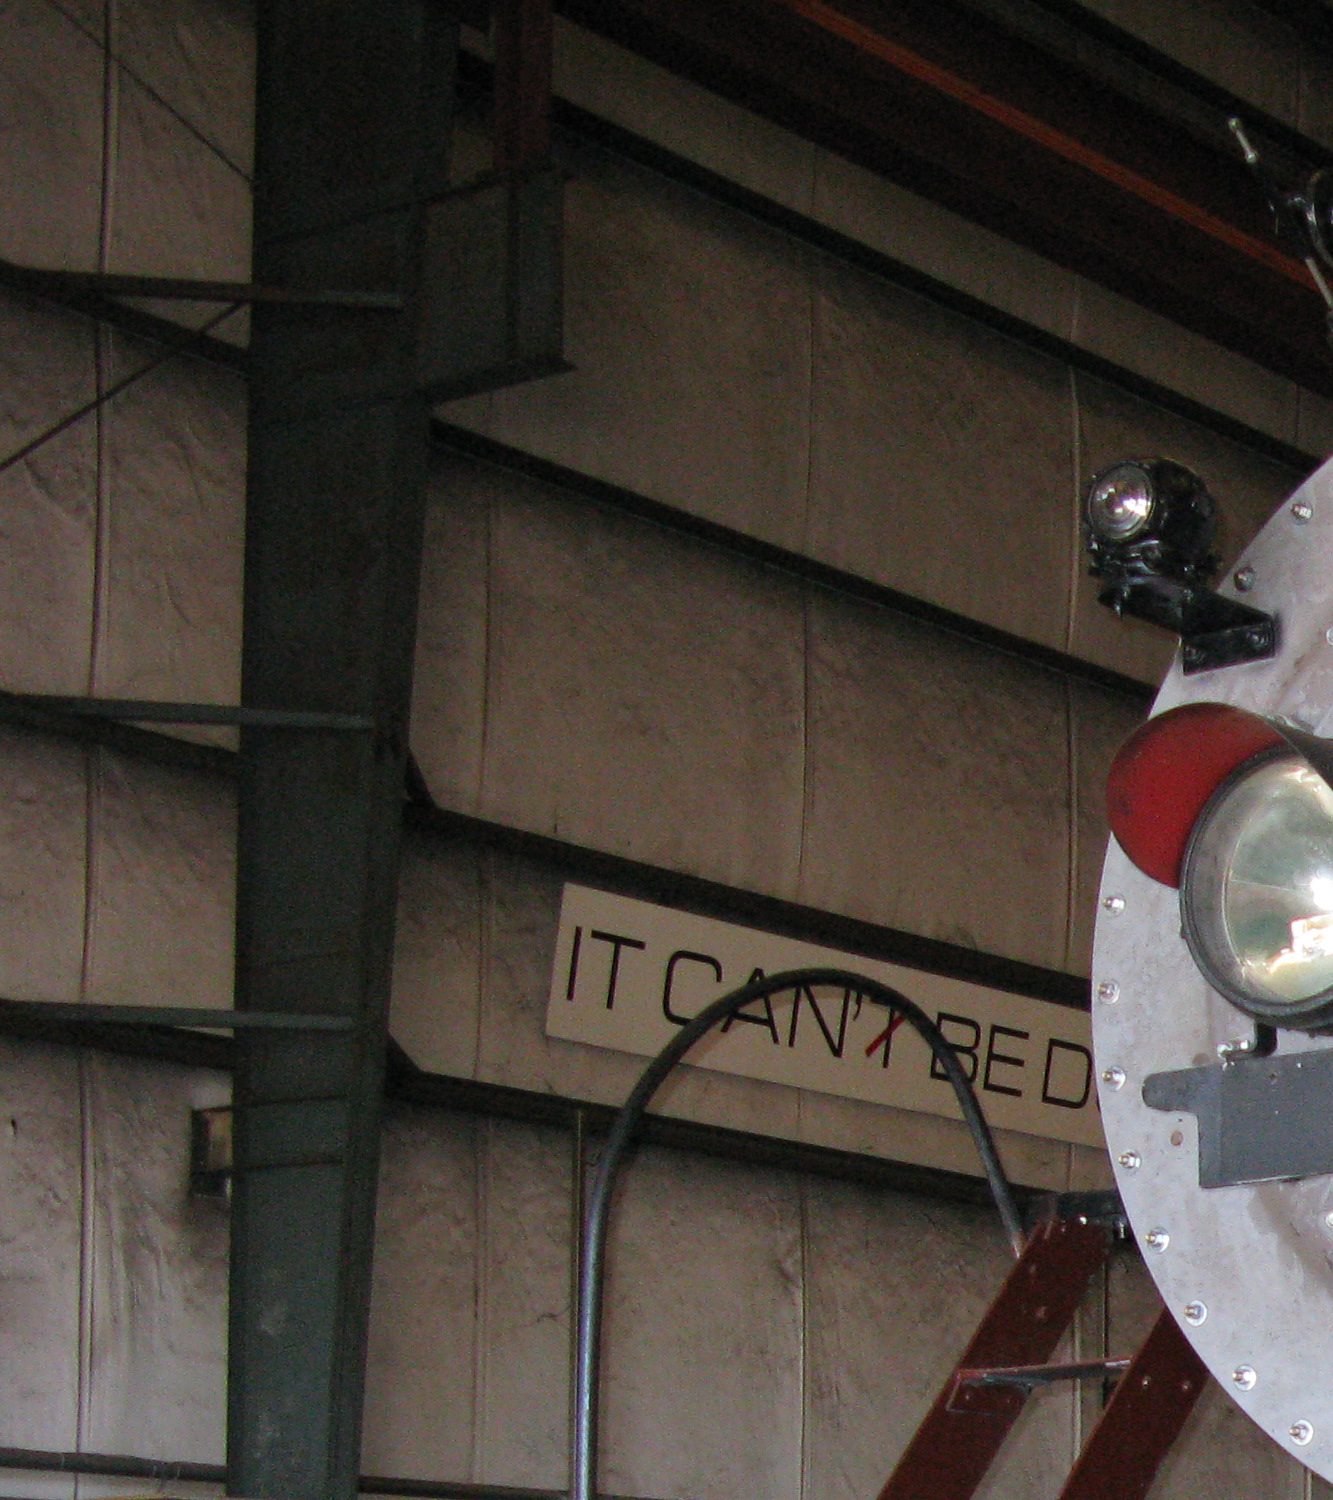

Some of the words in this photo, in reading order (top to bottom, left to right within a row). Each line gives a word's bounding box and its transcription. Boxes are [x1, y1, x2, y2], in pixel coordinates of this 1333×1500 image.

[567, 926, 646, 1009] IT
[931, 1012, 1029, 1097] BE
[1042, 1038, 1100, 1110] D
